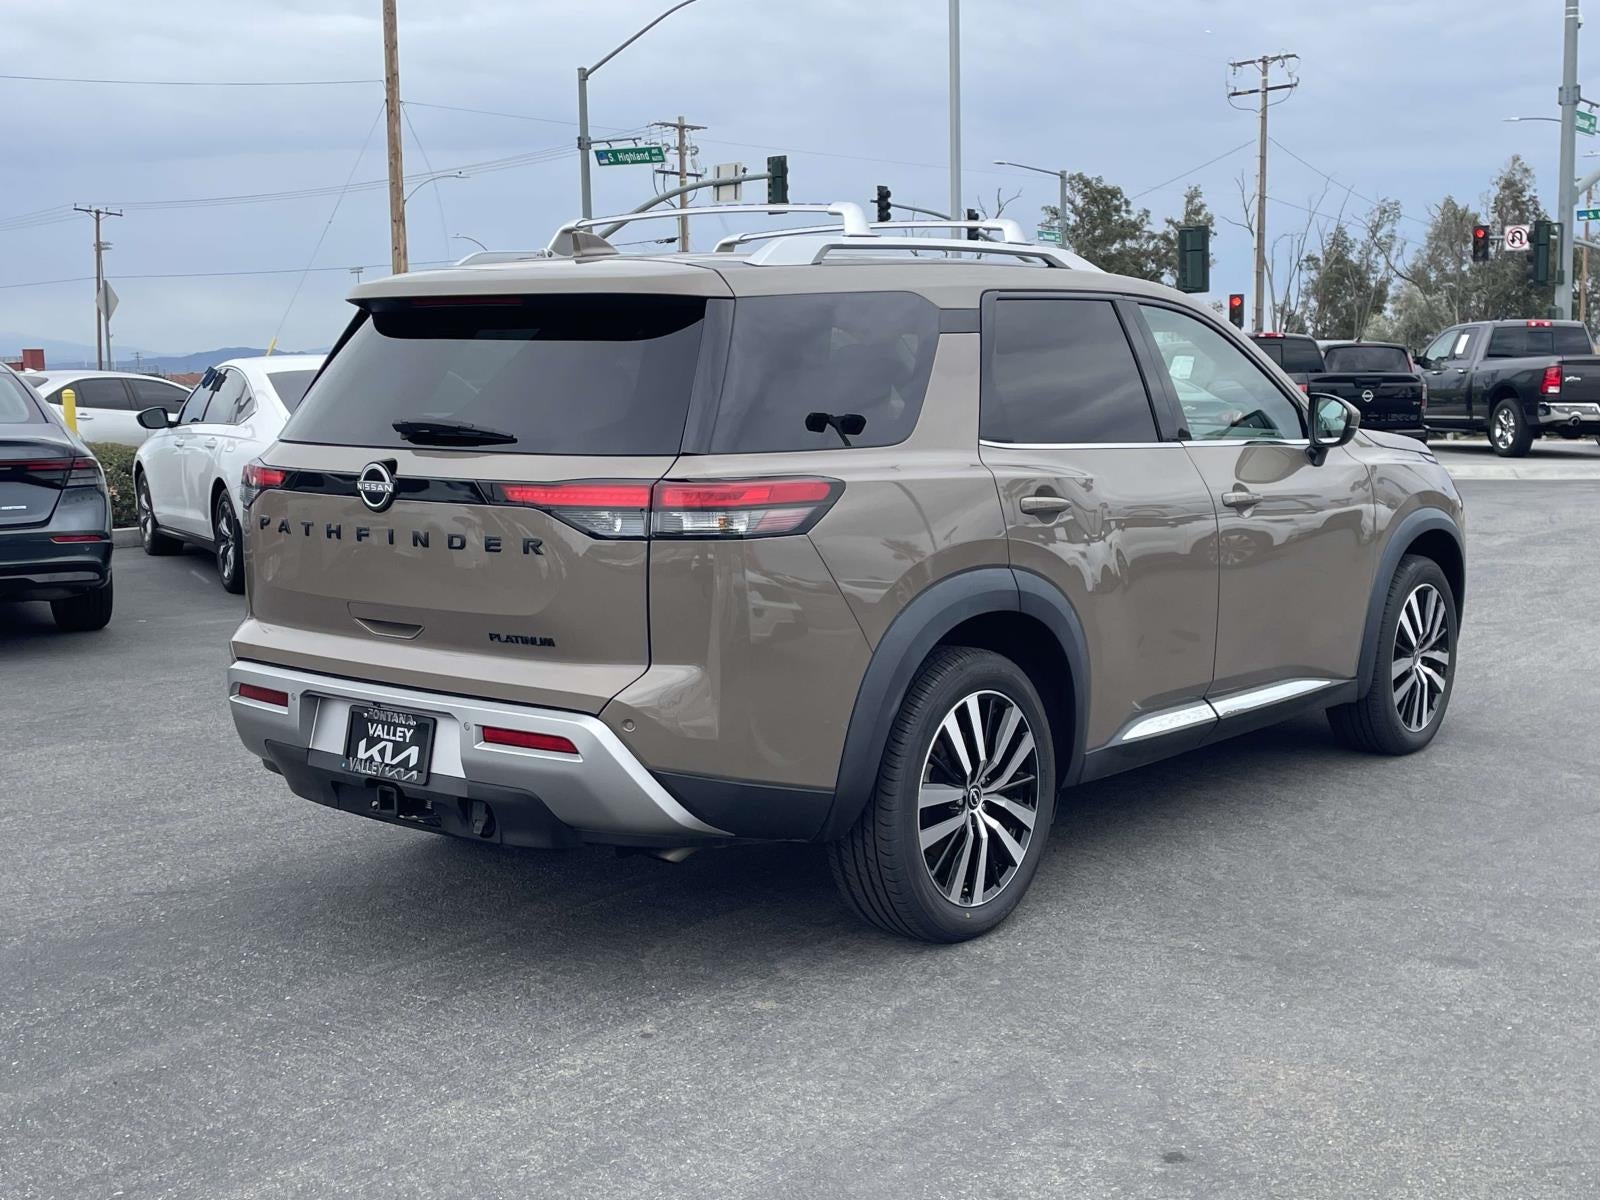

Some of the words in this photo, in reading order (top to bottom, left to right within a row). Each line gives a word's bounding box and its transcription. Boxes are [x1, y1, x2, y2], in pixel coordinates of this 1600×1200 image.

[617, 152, 649, 163] Highland
[357, 481, 394, 492] NISSAN
[259, 515, 544, 556] PATHFINDER
[488, 632, 556, 647] PLATINUM
[367, 708, 414, 726] FONTANA
[367, 722, 414, 743] VALLEY
[357, 737, 419, 768] KIA
[349, 757, 385, 776] VALLEY
